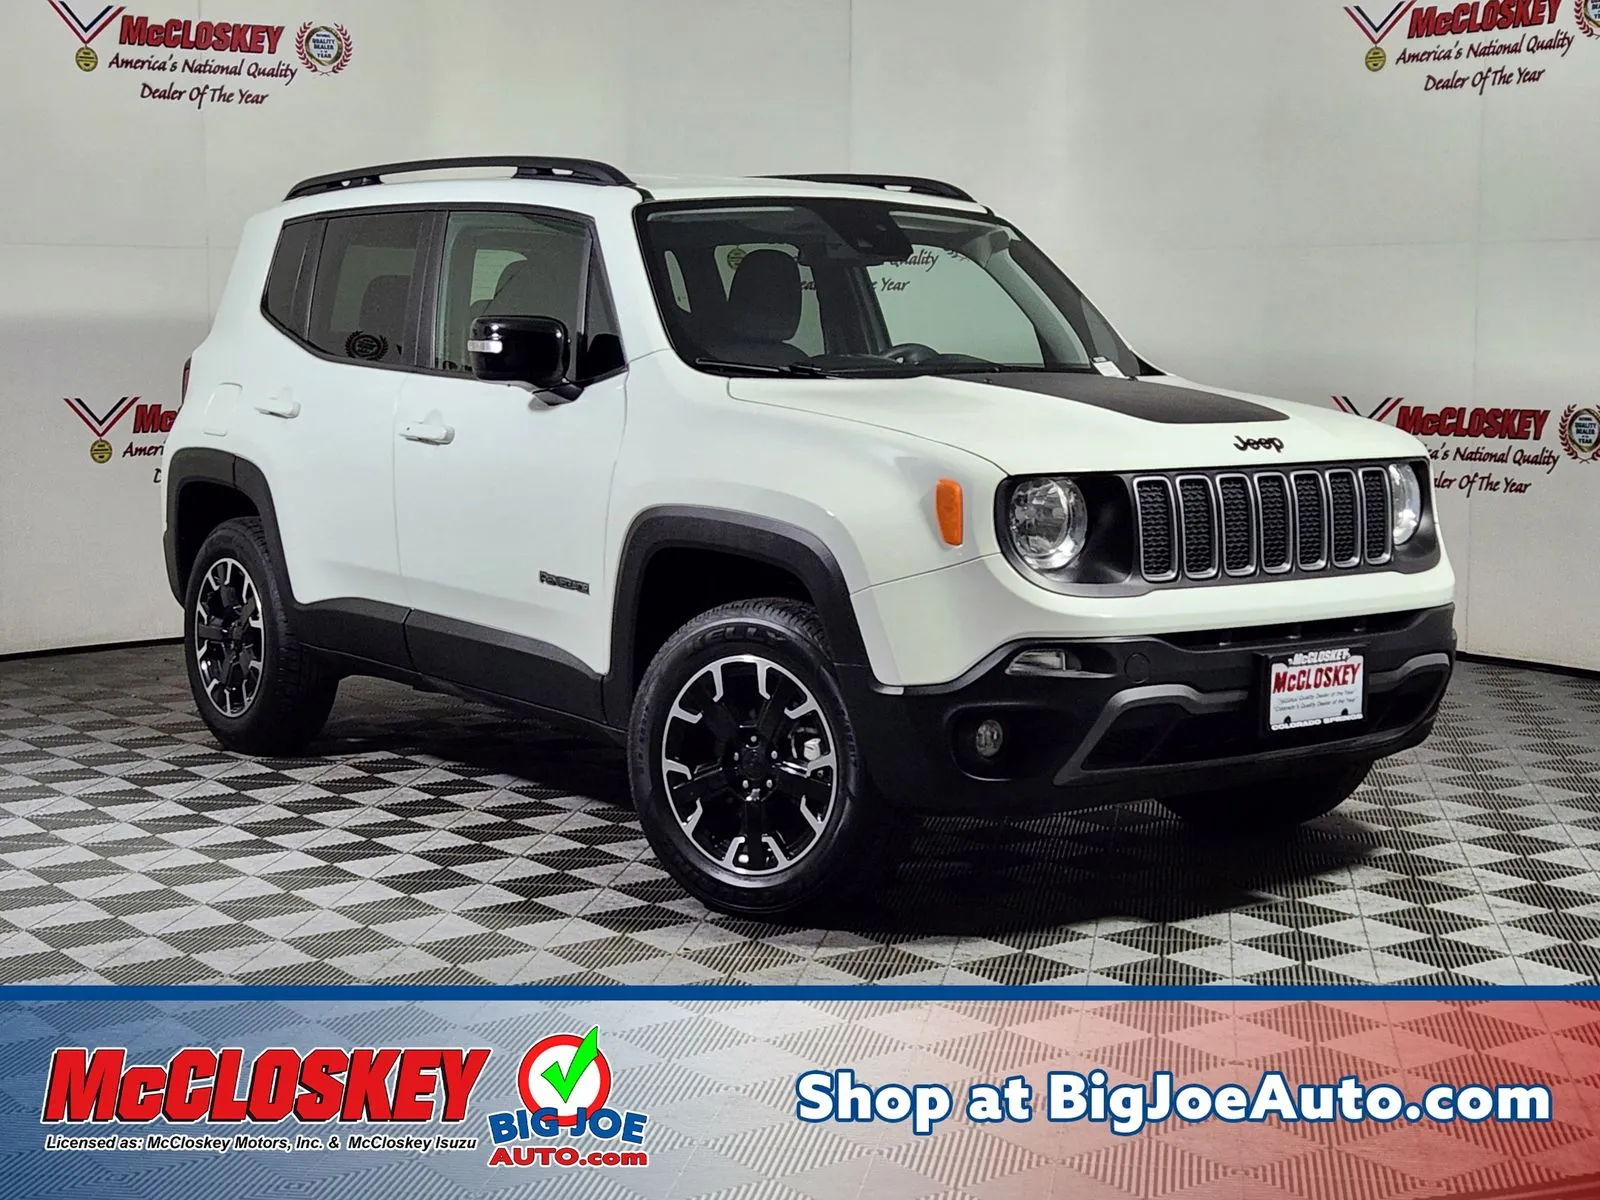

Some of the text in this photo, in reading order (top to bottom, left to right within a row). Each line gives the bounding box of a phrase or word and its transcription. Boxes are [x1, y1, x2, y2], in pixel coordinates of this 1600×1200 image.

[119, 15, 285, 54] McCLOSKEY
[1407, 0, 1561, 39] McCLOSKEY
[1395, 29, 1574, 65] America's National Quality
[108, 53, 298, 86] America's National Quality
[1424, 65, 1545, 95] Dealer Of The Year
[140, 83, 269, 109] Dealer Of The Year
[881, 277, 910, 291] Year
[1396, 406, 1551, 440] McCLOSKEY
[122, 442, 166, 458] Ameri
[1233, 435, 1284, 453] Jeep
[1453, 445, 1512, 465] National
[1512, 448, 1560, 474] Quality
[1458, 472, 1479, 498] Of
[1478, 473, 1500, 492] The
[1503, 477, 1532, 494] Year
[1272, 663, 1361, 694] McCLOSKEY
